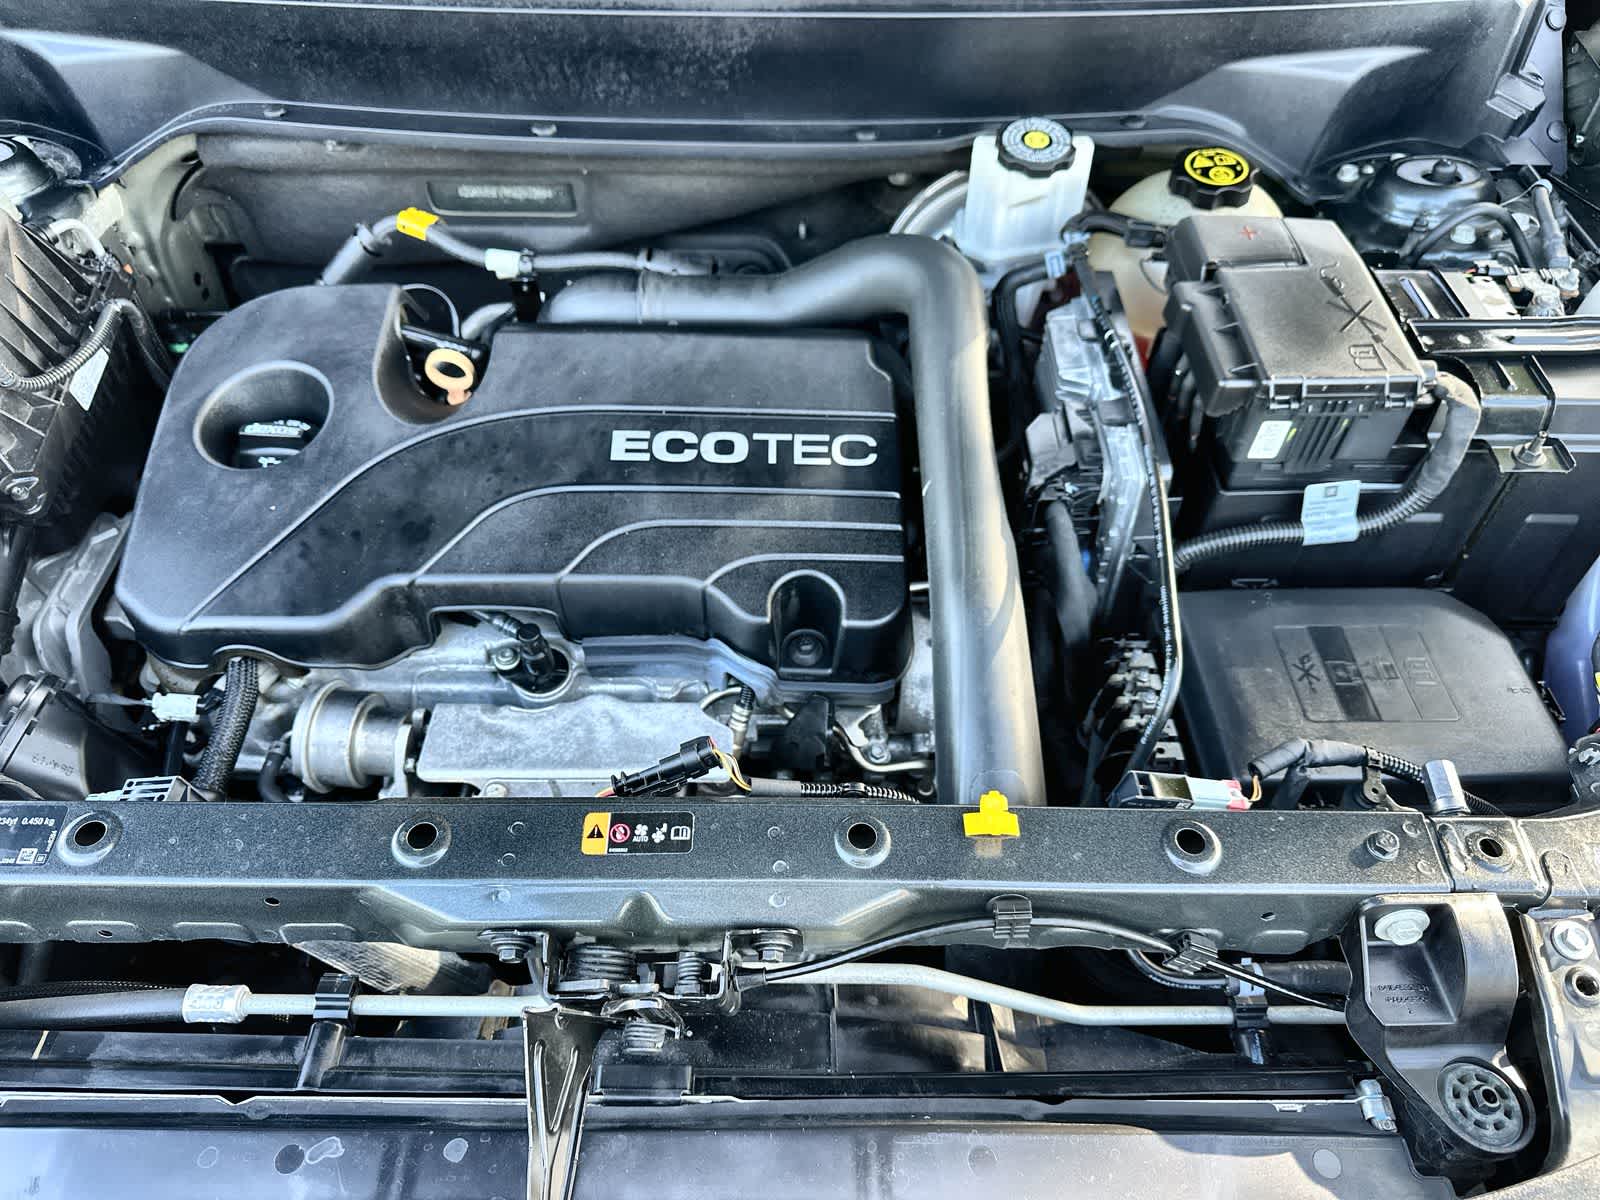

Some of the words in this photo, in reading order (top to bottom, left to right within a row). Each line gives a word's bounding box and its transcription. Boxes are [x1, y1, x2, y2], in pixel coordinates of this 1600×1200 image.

[610, 430, 878, 466] ECOTEC
[22, 816, 44, 825] 0.450
[44, 817, 56, 826] kg
